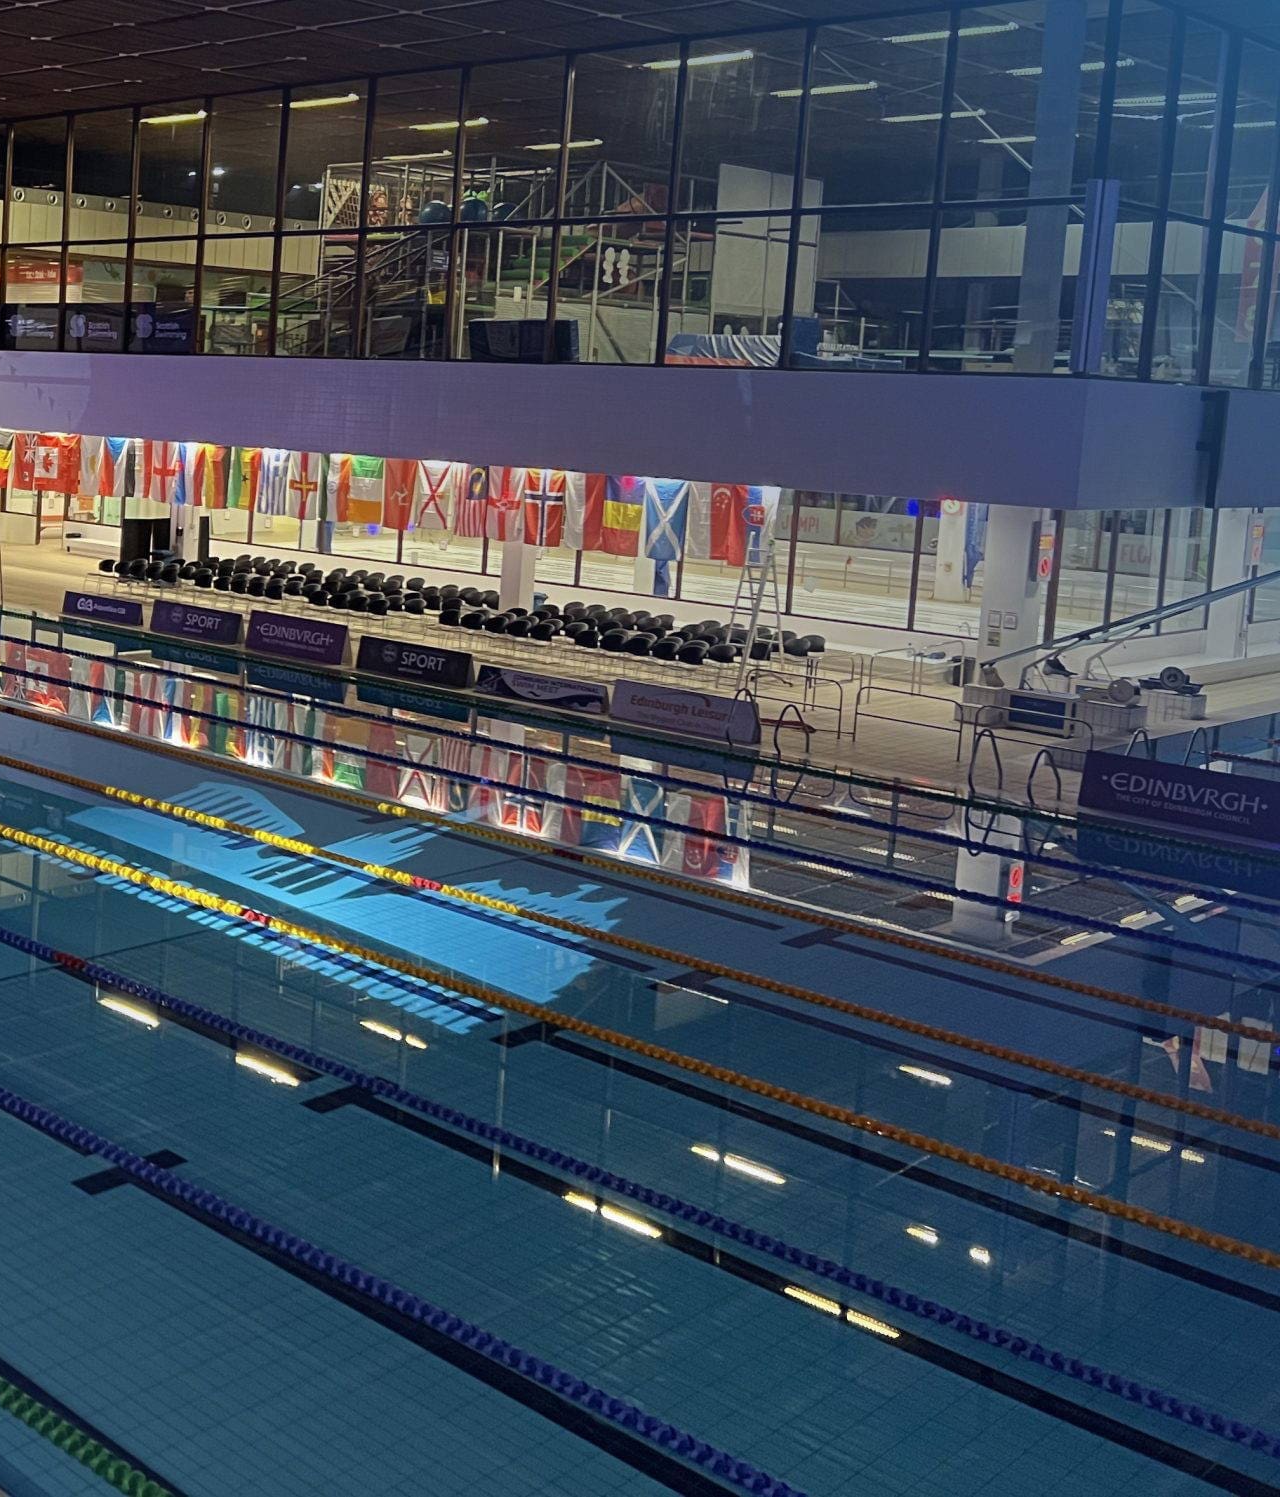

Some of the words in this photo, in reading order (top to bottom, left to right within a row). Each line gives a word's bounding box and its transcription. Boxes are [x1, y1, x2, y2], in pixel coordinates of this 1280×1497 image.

[782, 515, 820, 533] JMP!
[186, 612, 222, 630] SPORT
[401, 651, 446, 672] SPORT
[630, 694, 688, 716] Edinburgh
[1151, 799, 1162, 808] OF
